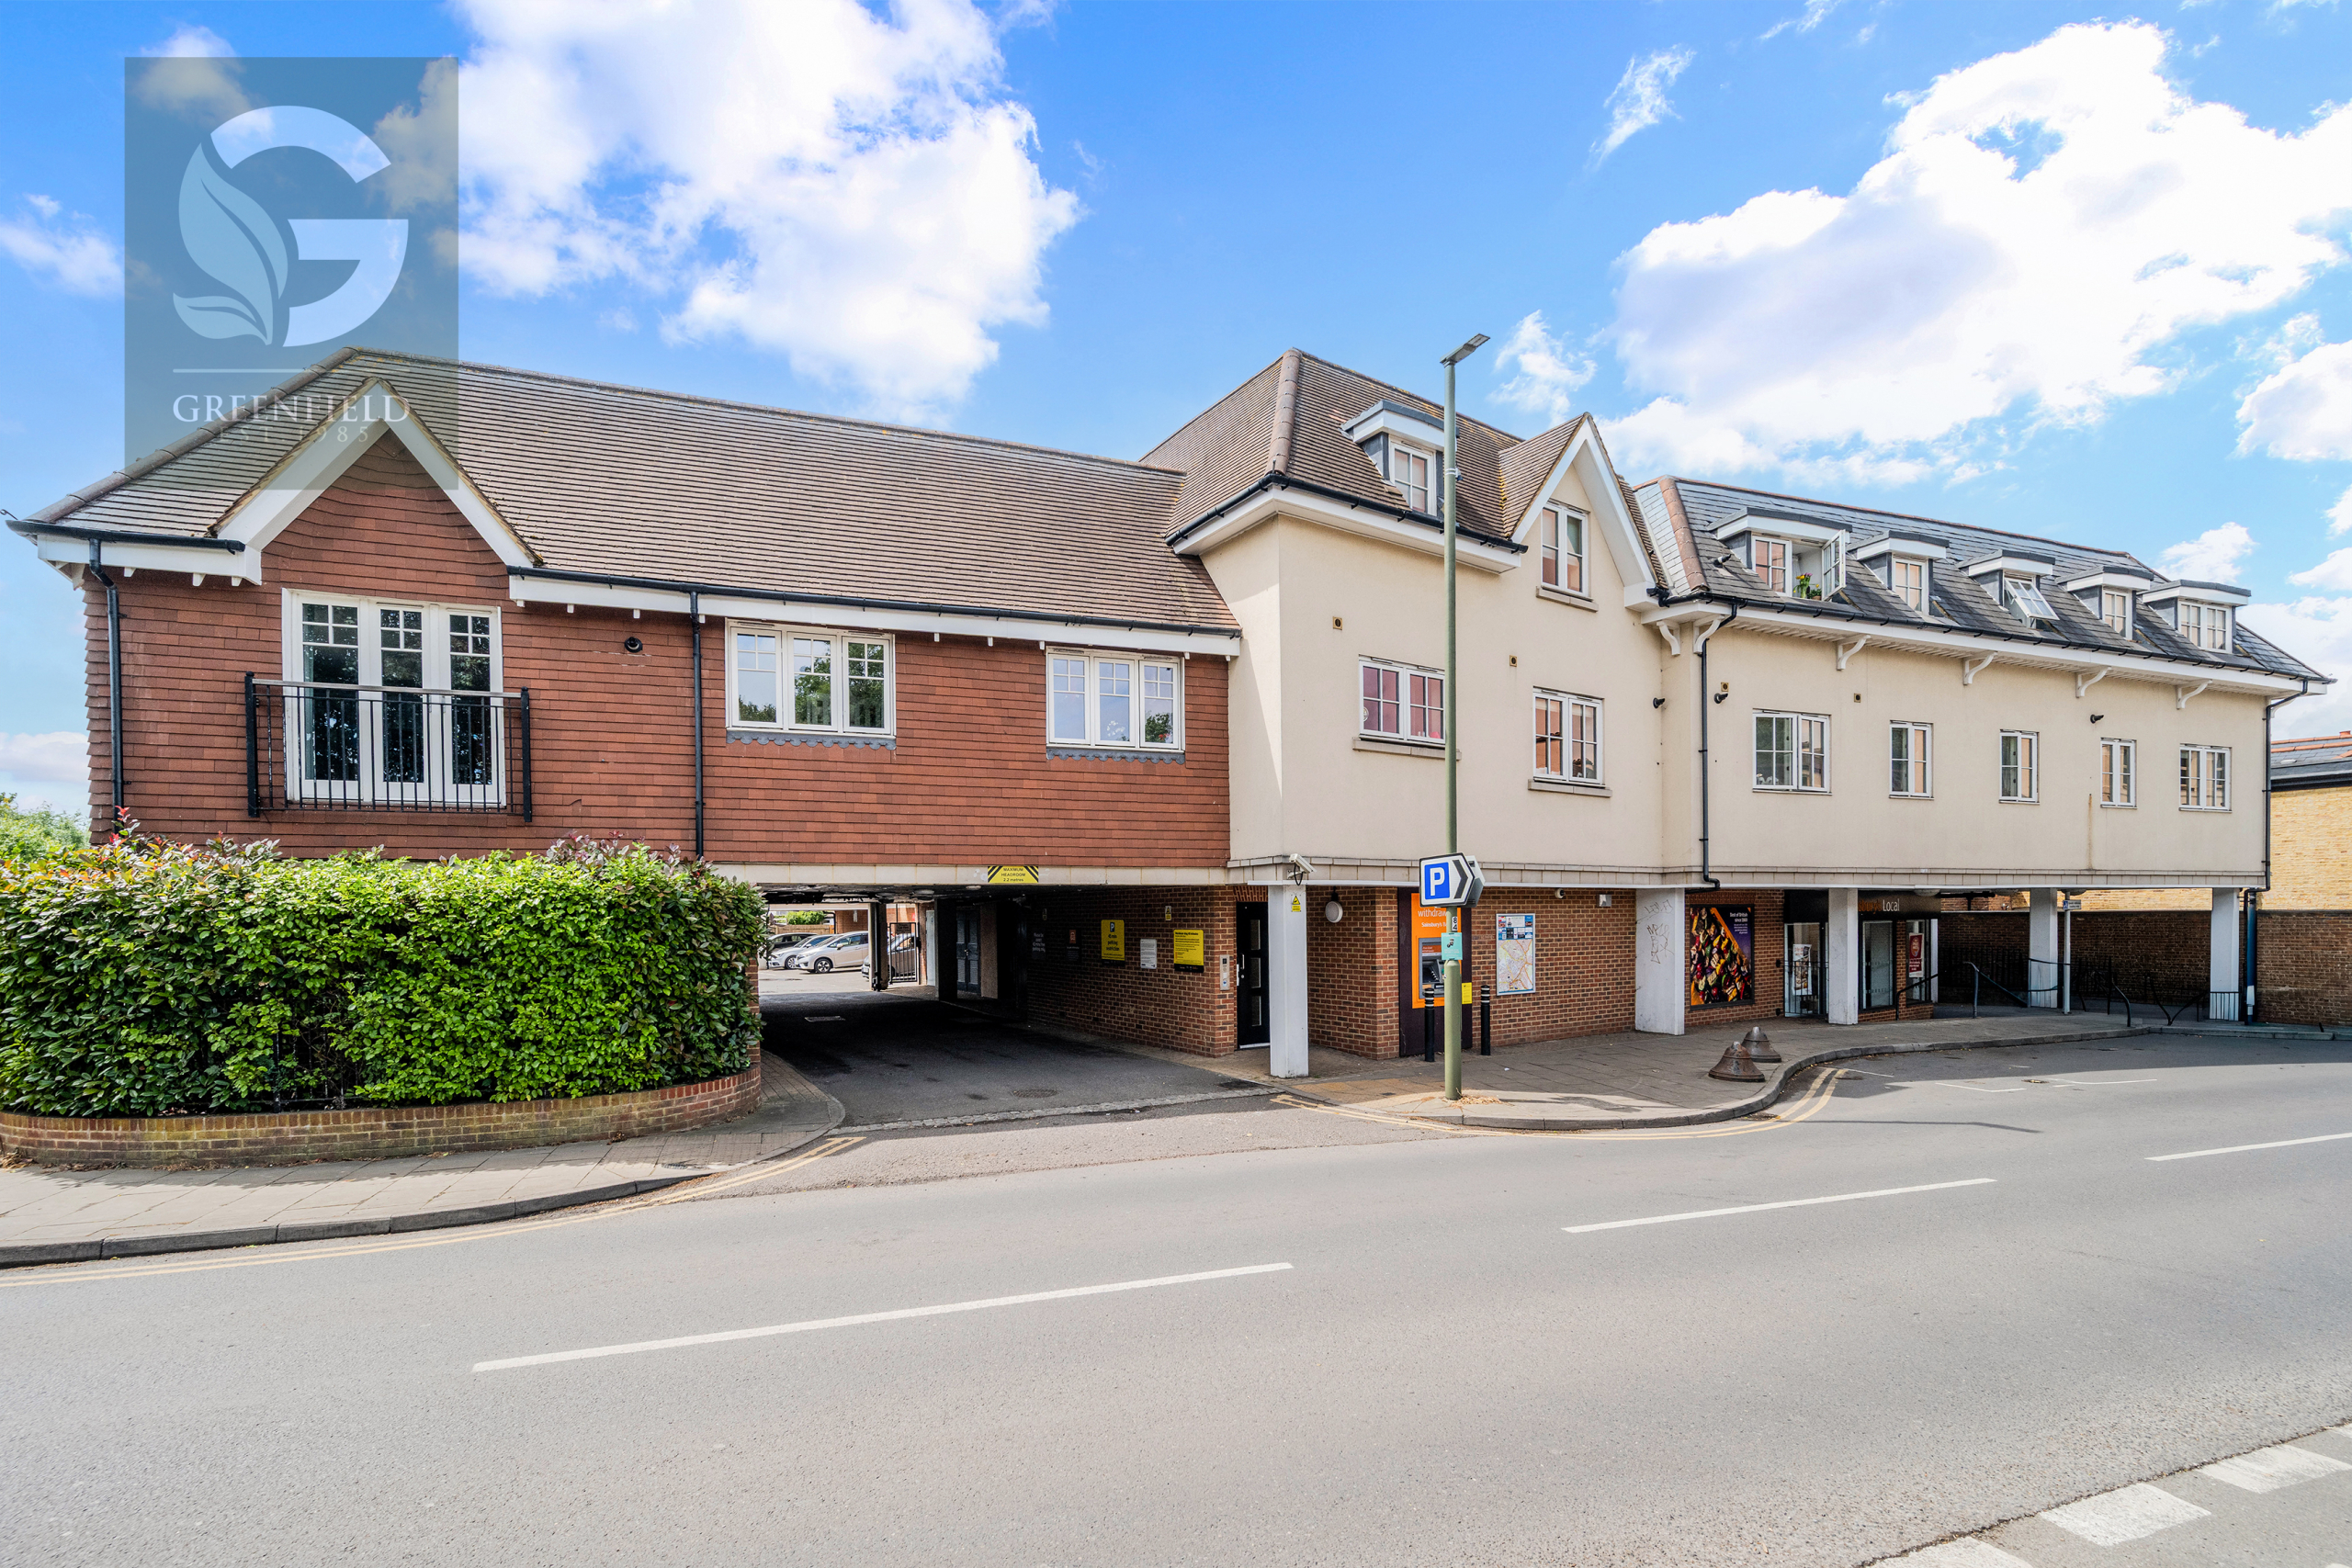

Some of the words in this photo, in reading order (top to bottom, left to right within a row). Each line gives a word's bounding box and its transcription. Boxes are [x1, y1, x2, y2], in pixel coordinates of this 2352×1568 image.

[1430, 867, 1445, 896] P
[1418, 908, 1447, 917] withdraw
[1858, 899, 1882, 914] sbury's
[1883, 898, 1900, 912] Local
